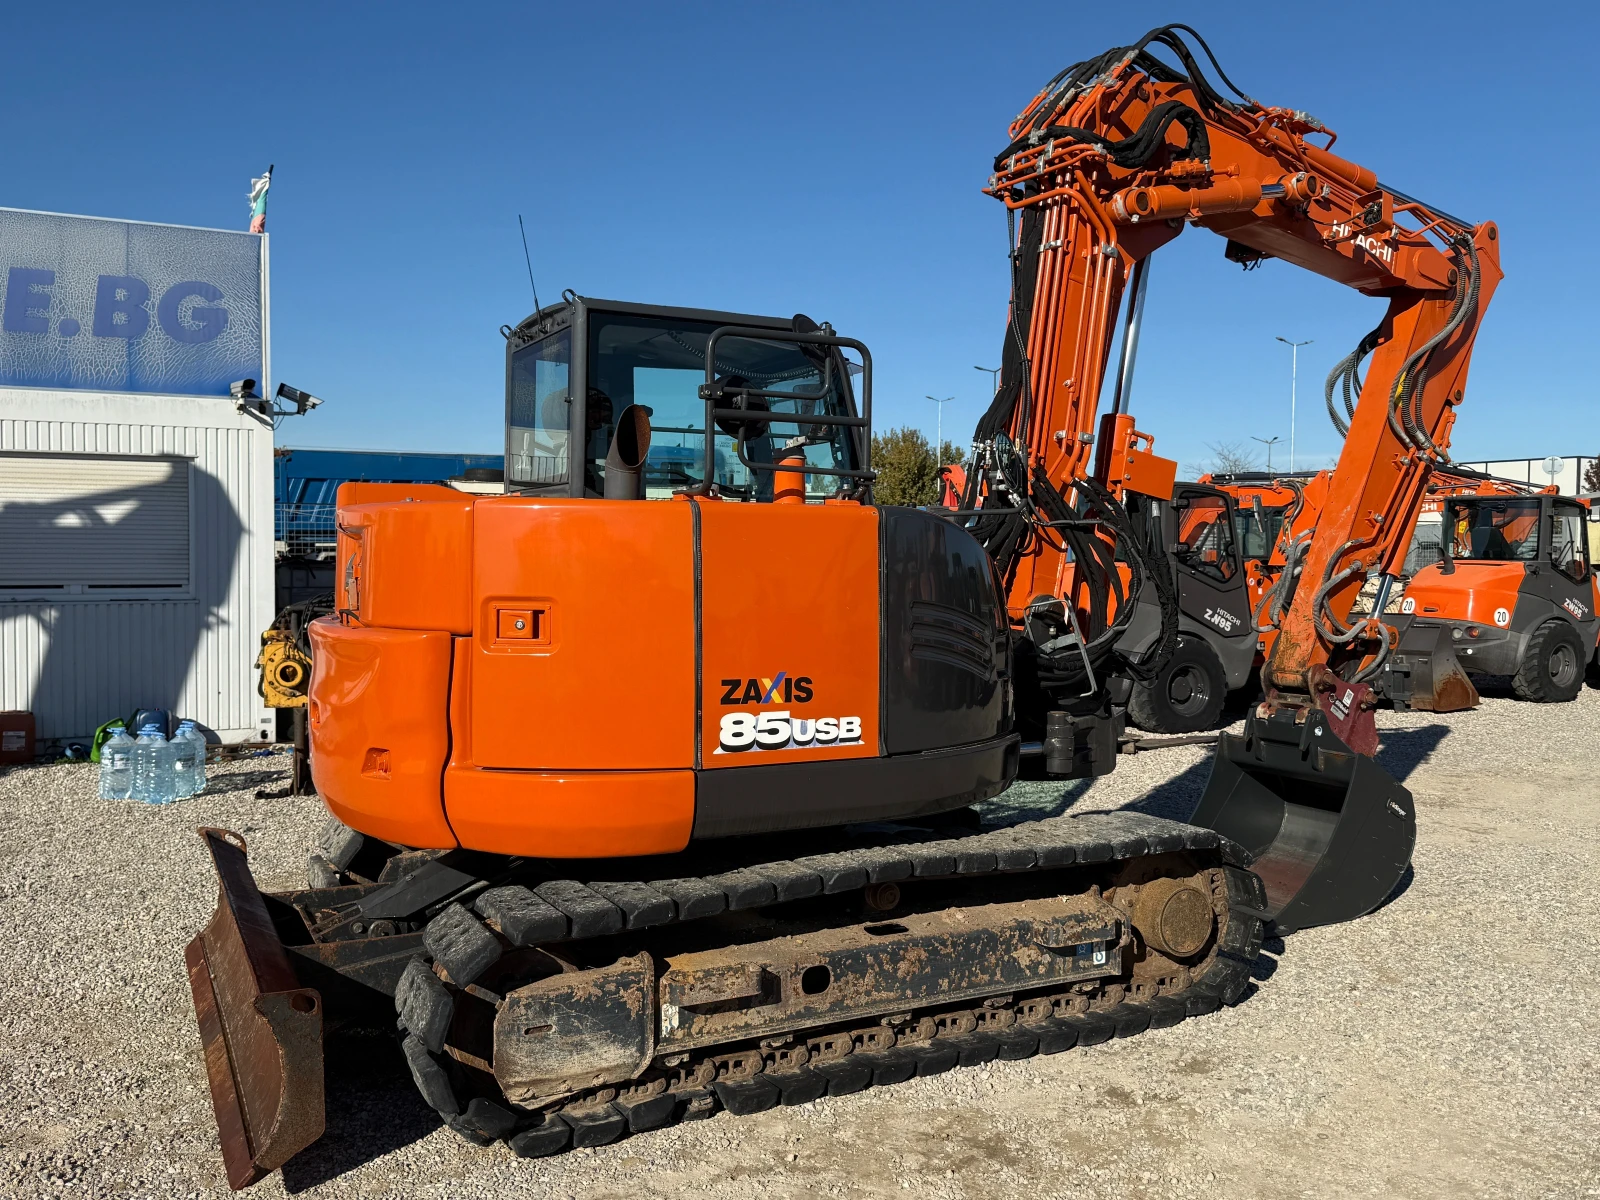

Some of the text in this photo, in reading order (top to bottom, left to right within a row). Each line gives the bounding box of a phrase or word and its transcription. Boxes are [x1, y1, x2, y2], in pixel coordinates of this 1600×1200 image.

[3, 266, 229, 344] E.BG
[1403, 600, 1413, 611] 20
[1563, 597, 1583, 618] ZW95
[1572, 597, 1589, 613] HITACHI
[1216, 607, 1241, 626] HITACHI
[1496, 611, 1507, 623] 20
[721, 671, 814, 705] ZAXIS
